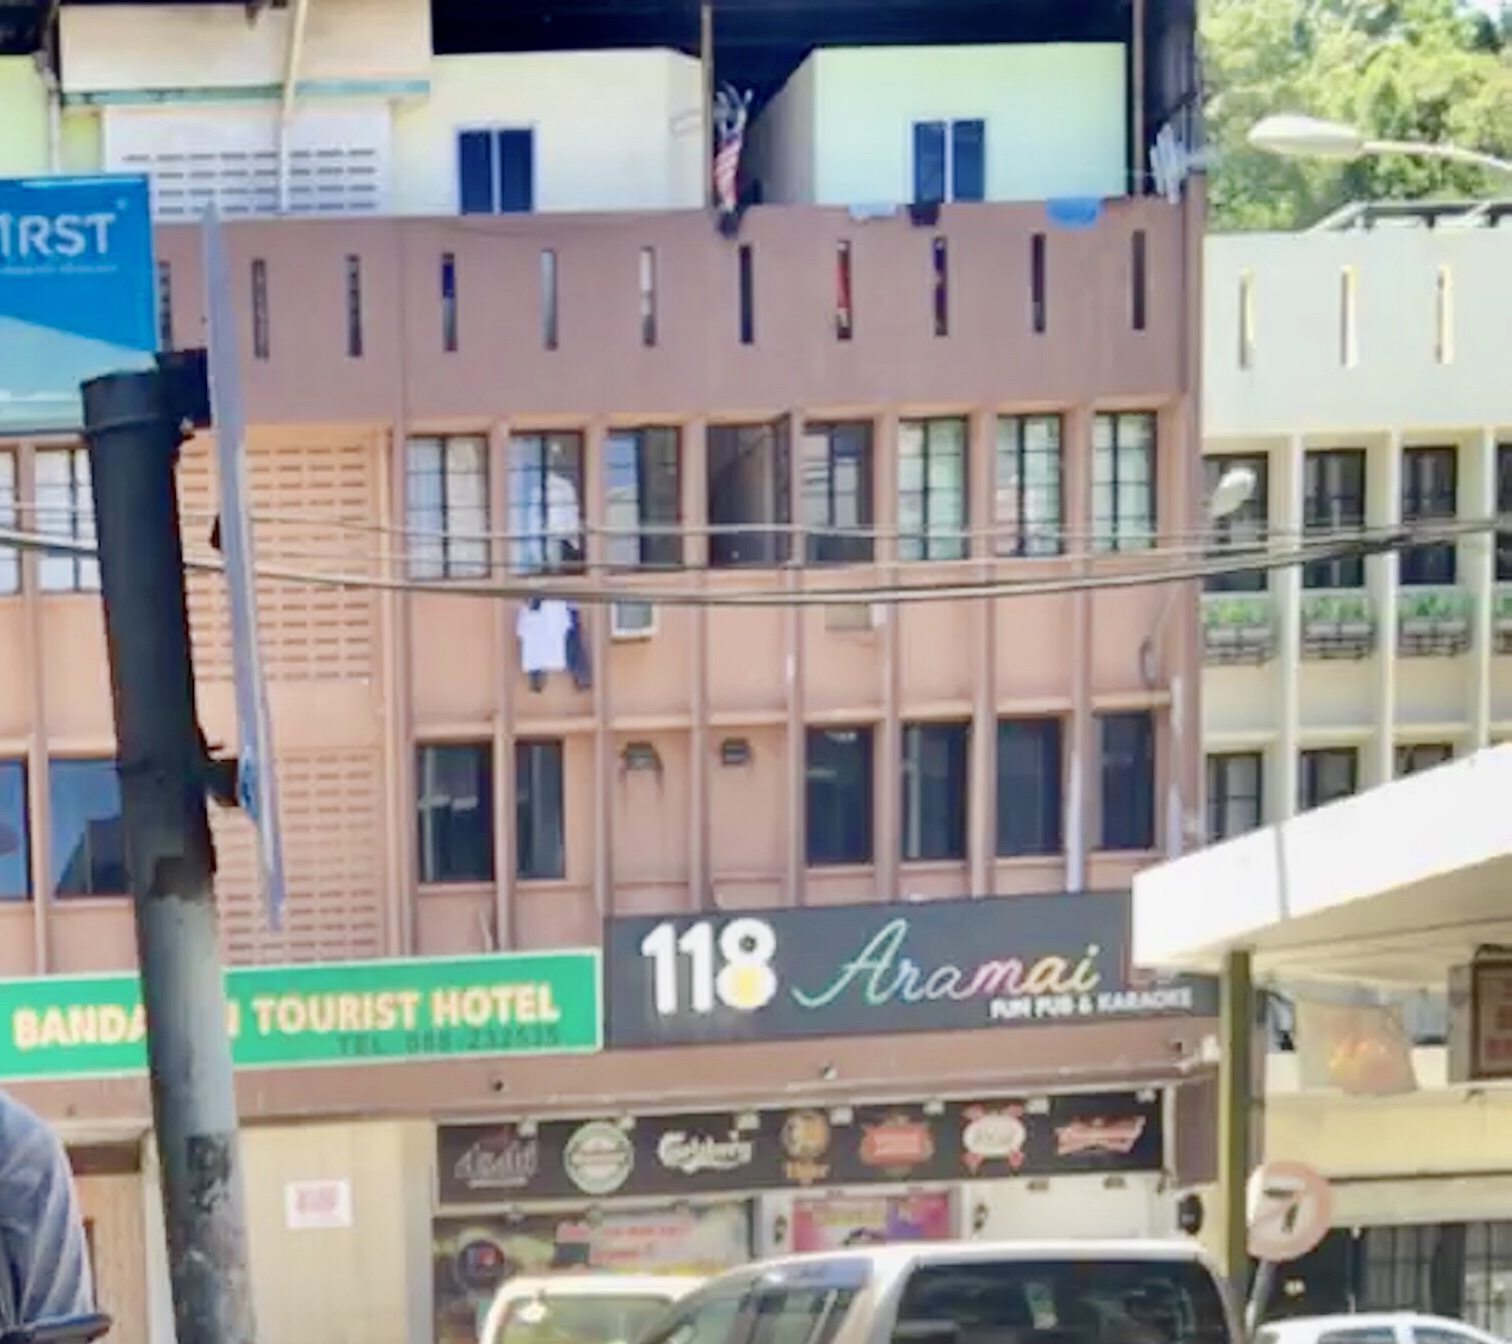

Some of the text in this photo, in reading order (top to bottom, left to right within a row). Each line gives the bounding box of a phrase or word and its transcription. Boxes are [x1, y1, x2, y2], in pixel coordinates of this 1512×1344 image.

[641, 917, 1100, 1015] 118 Aramai
[251, 990, 420, 1034] TOURIST
[431, 980, 560, 1028] HOTEL
[1097, 987, 1193, 1012] KARAOKE
